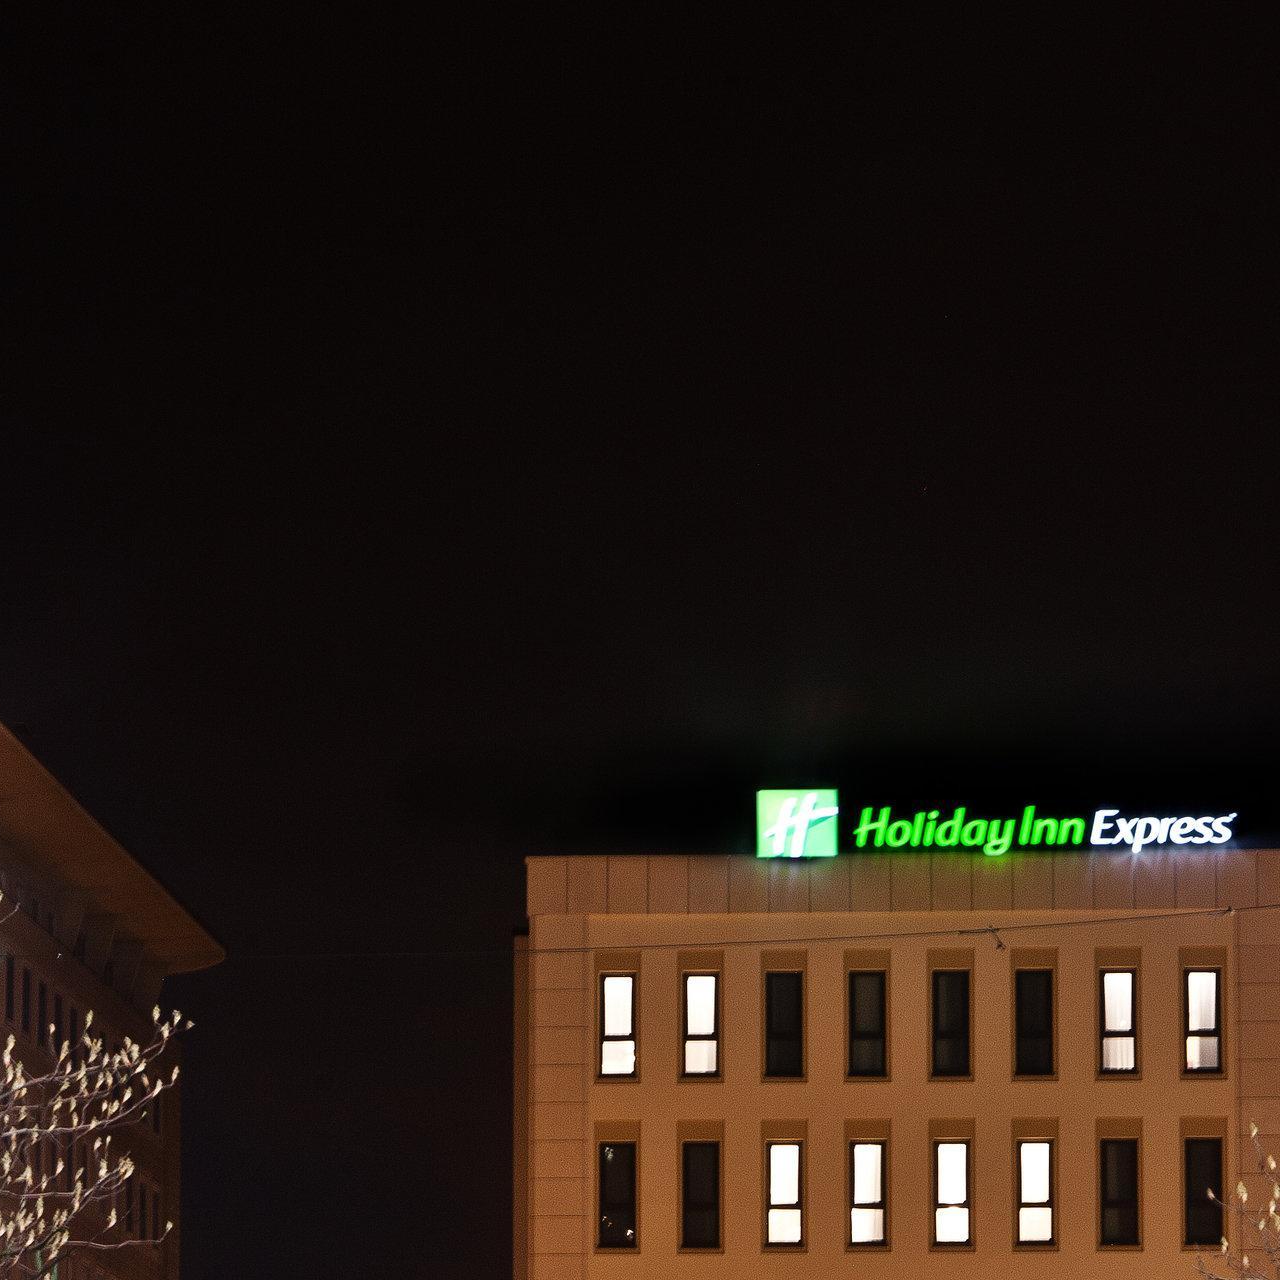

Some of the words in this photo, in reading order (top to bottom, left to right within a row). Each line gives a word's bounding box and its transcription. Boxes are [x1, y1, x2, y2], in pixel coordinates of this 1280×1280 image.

[852, 806, 1016, 856] Holiday
[1018, 805, 1086, 846] Inn
[1089, 808, 1238, 854] Express
